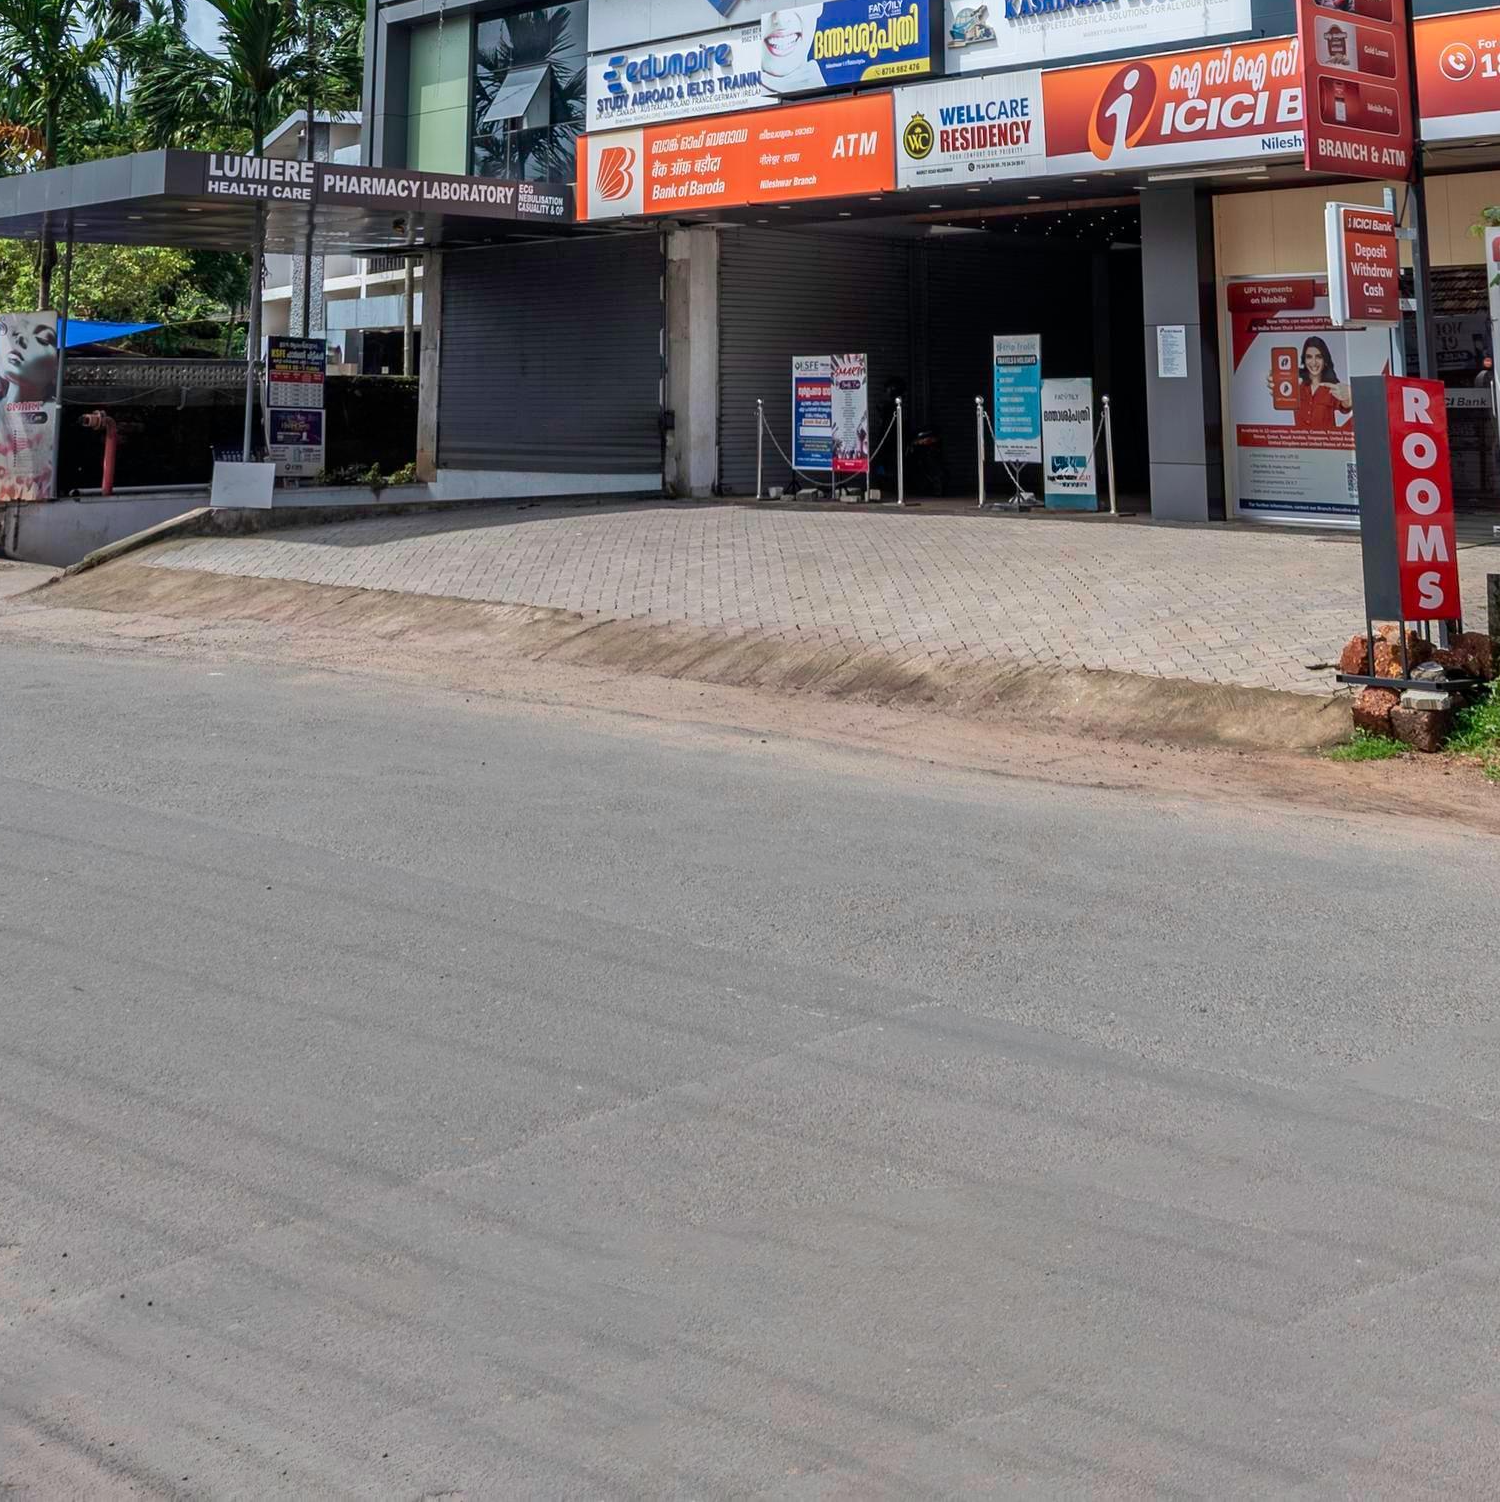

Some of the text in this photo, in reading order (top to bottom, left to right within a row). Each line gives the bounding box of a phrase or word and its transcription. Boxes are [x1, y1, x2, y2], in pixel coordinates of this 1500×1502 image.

[1019, 25, 1031, 35] THE
[1032, 21, 1067, 34] COMPLETE
[1068, 16, 1107, 29] LOGISTICAL
[1109, 9, 1149, 22] SOLUTIONS
[1151, 5, 1163, 15] FOR
[1165, 3, 1179, 12] ALL
[1179, 0, 1201, 10] YOUR
[1364, 46, 1374, 55] Gold
[1478, 38, 1497, 50] For
[597, 71, 762, 112] STUDY ABROAD & IELTS TRAININ
[940, 98, 1029, 126] WELLCARE
[1160, 91, 1269, 136] ICICI
[1367, 103, 1382, 113] Mobile
[832, 132, 878, 159] ATM
[940, 120, 1031, 153] RESIDENCY
[1318, 138, 1406, 167] BRANCH & ATM
[209, 154, 315, 184] LUMIERE
[652, 160, 668, 178] बैंक
[694, 154, 722, 176] बड़ौदा
[207, 180, 312, 200] HEALTH CARE
[323, 174, 515, 204] PHARMACY LABORATORY
[518, 184, 534, 194] ECG
[652, 179, 725, 200] Bank of Baroda
[760, 175, 817, 190] Nileshwar Branch
[518, 193, 564, 206] NEBULISATION
[517, 203, 564, 216] CASUALITY & OP
[1353, 217, 1392, 232] ICICI Bank
[1355, 243, 1387, 260] Deposit
[1351, 262, 1393, 277] Withdraw
[1258, 285, 1293, 295] Payments
[1363, 282, 1384, 296] Cash
[1457, 397, 1487, 406] Bank
[1402, 386, 1450, 610] ROOMS
